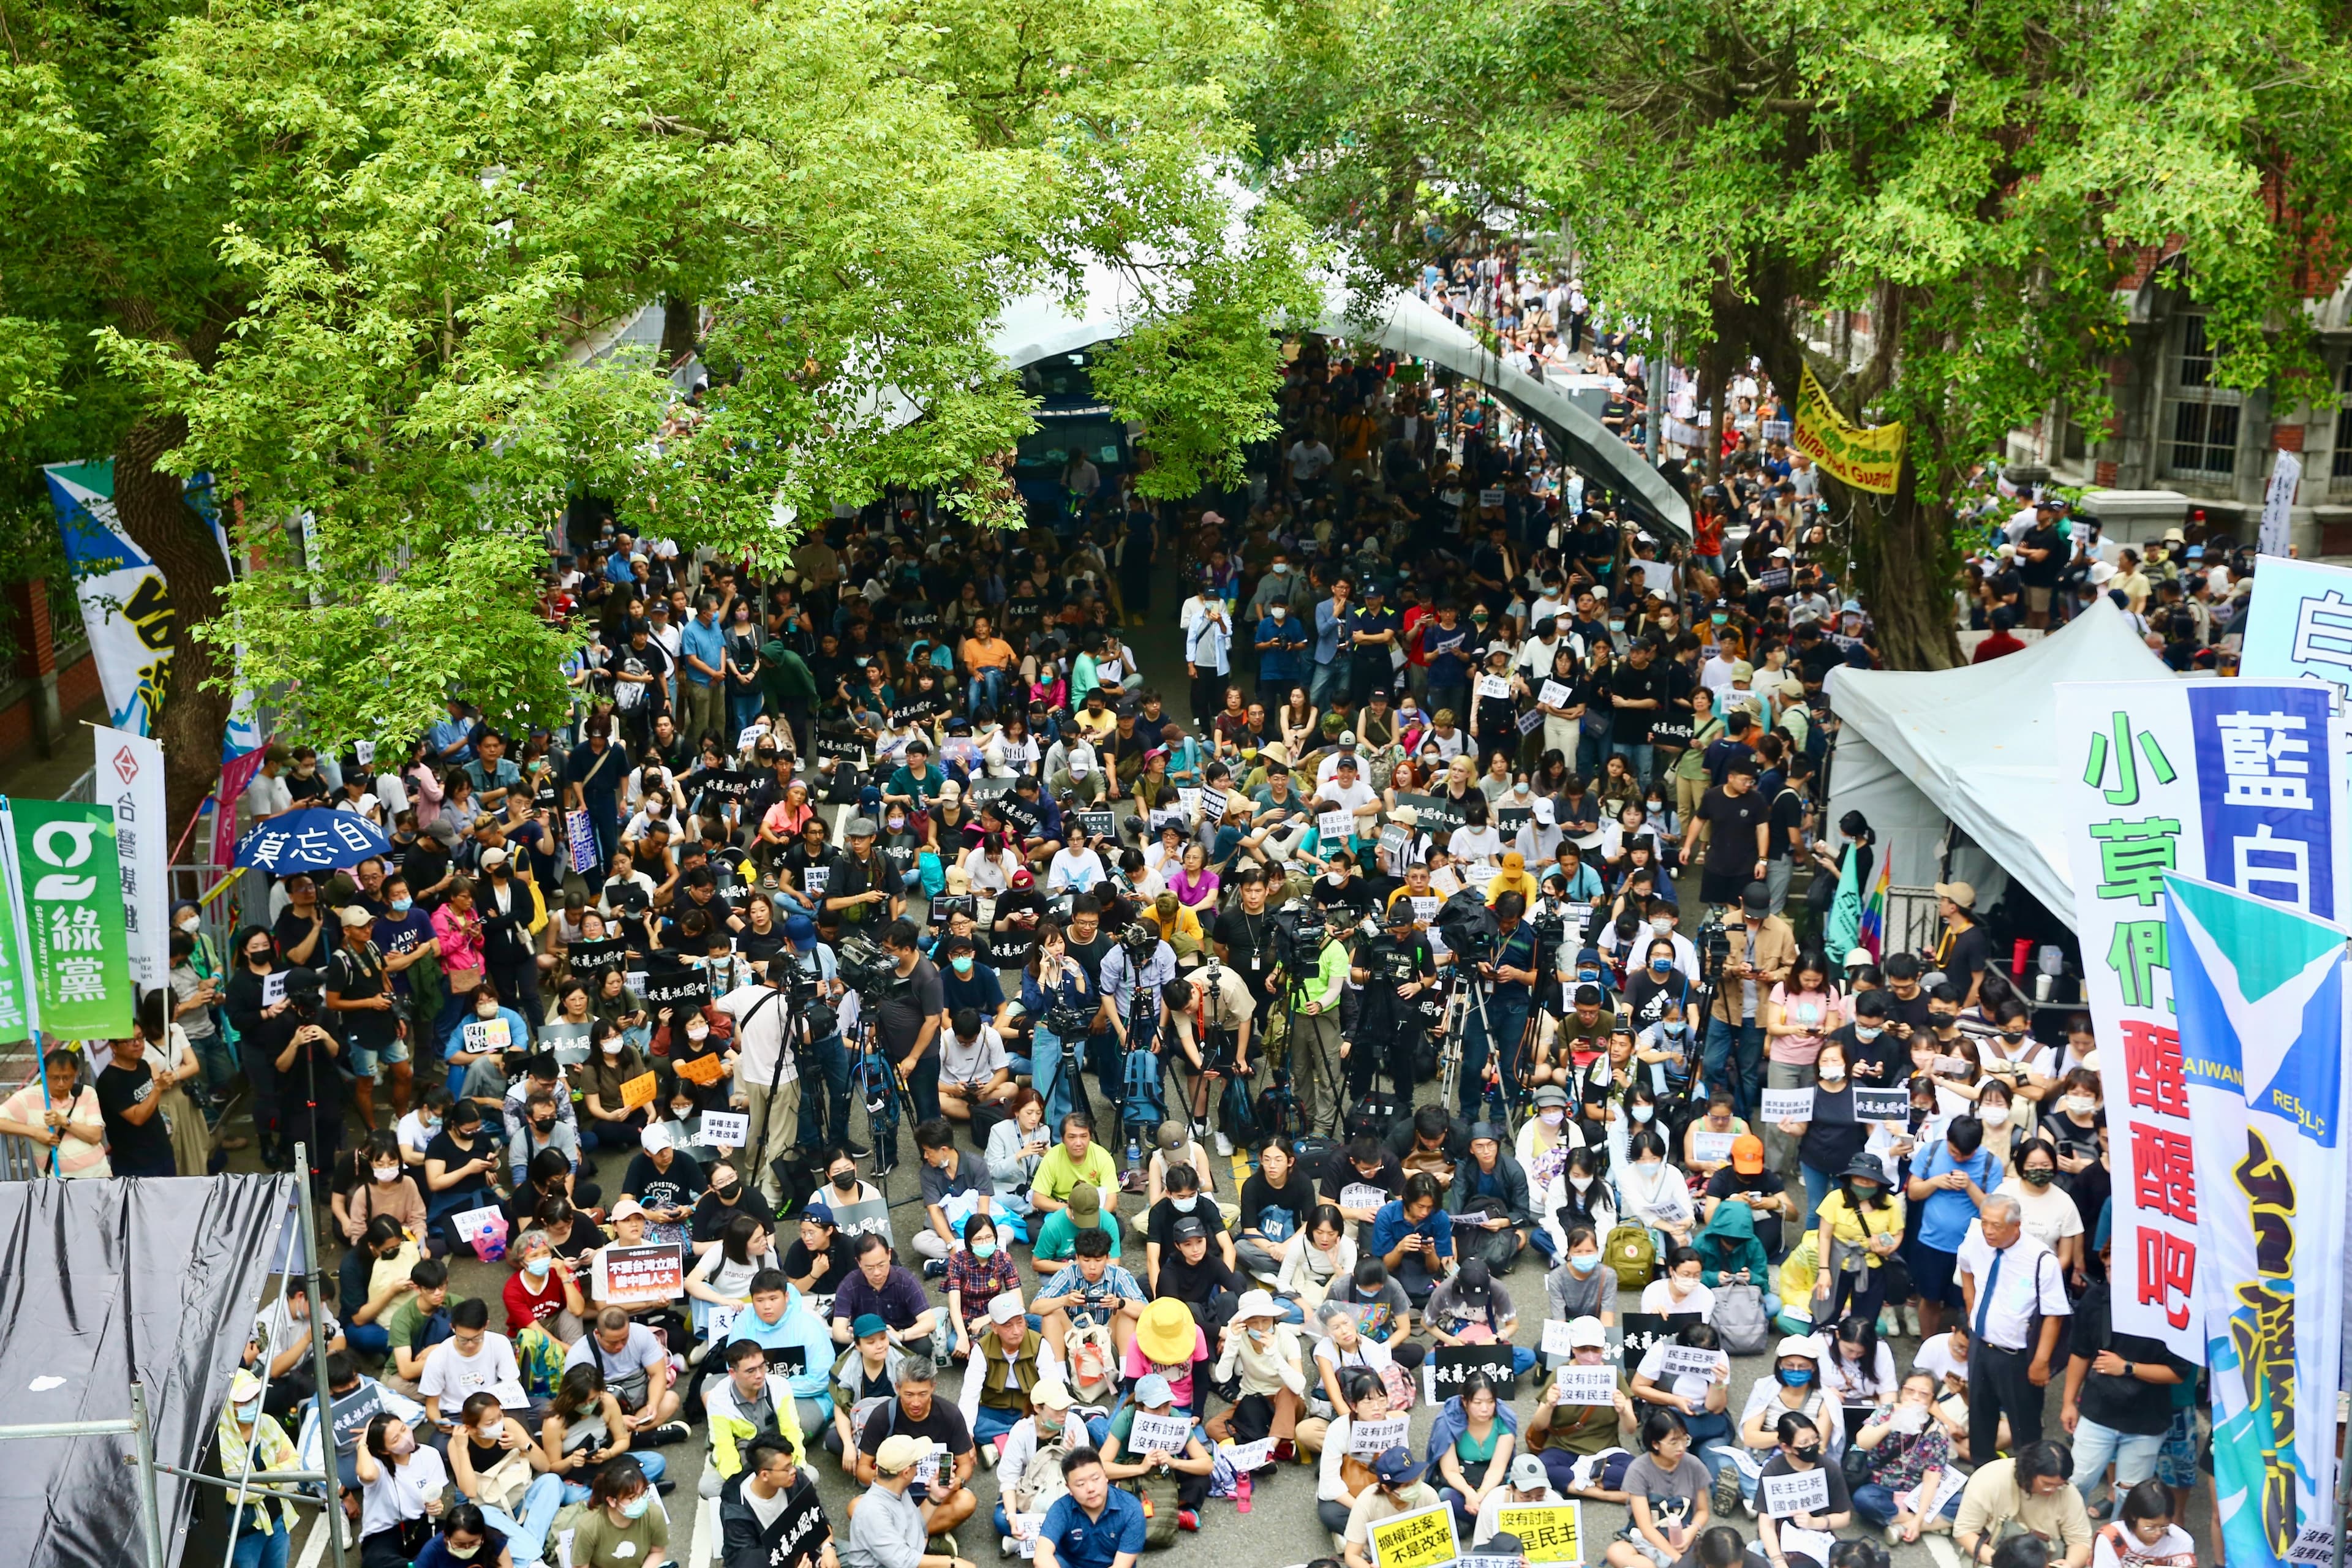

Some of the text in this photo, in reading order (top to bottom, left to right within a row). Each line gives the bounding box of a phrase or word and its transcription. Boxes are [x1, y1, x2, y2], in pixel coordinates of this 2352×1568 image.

[1322, 813, 1351, 824] 民主已死
[34, 905, 45, 938] GREEN
[39, 937, 48, 967] PARTY
[51, 905, 107, 1003] 綠黨
[609, 1257, 679, 1275] 不要台灣立院
[1667, 1349, 1716, 1365] 民主已死
[1562, 1373, 1611, 1385] 沒有討論
[1562, 1390, 1611, 1401] 沒有民主
[1137, 1419, 1186, 1437] 沒有討論
[1357, 1423, 1404, 1437] 沒有討論
[1134, 1436, 1182, 1452] 沒有民主
[1355, 1438, 1403, 1450] 沒有民主
[1770, 1477, 1822, 1495] 民主已死
[1501, 1511, 1556, 1527] 沒有討論
[1378, 1514, 1436, 1551] 擴權法案
[1390, 1526, 1453, 1564] 不是改革
